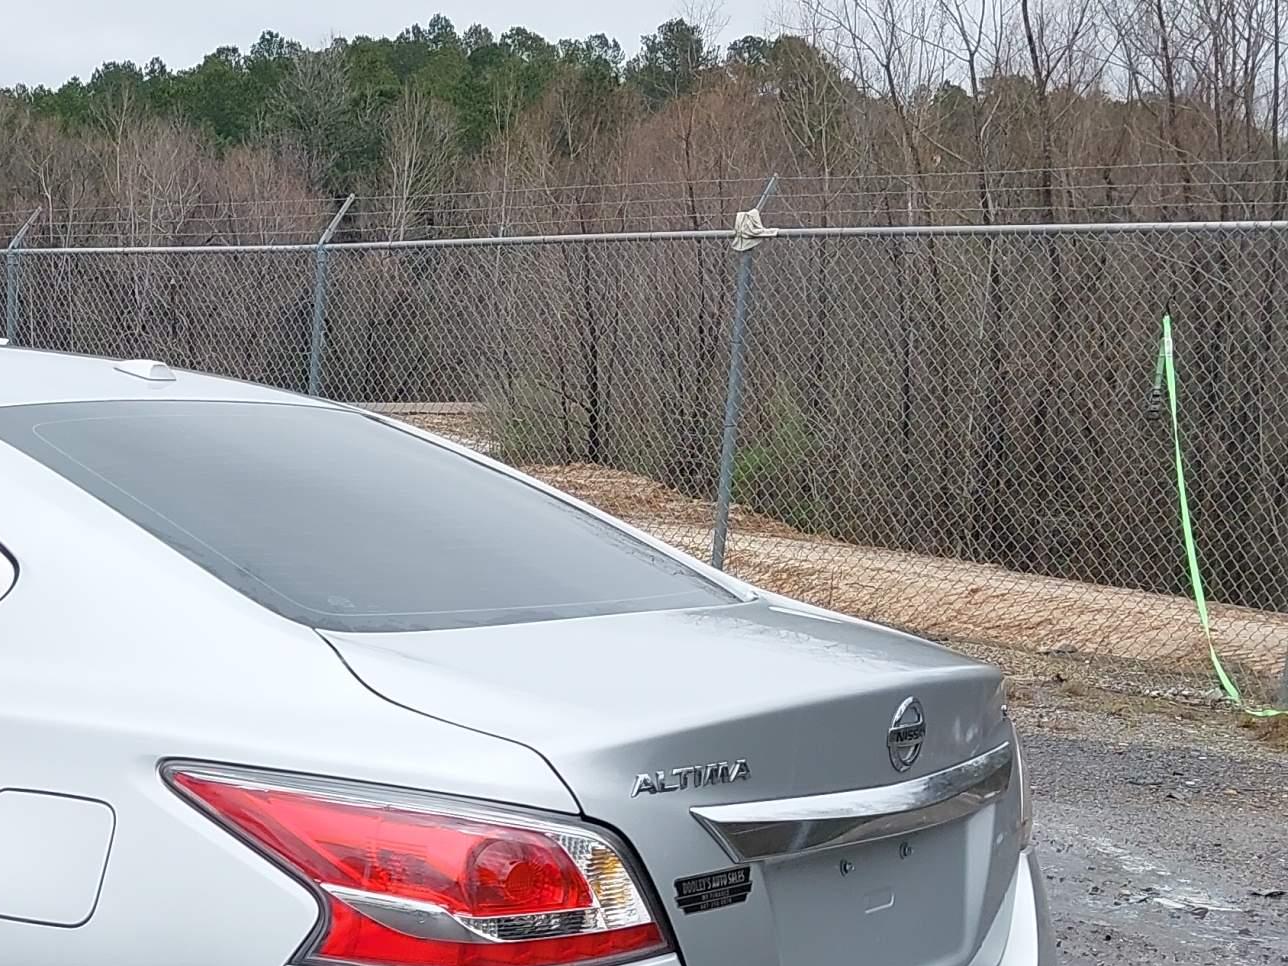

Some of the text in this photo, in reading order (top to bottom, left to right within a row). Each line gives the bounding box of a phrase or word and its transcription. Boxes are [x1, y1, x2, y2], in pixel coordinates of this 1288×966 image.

[896, 727, 926, 742] NISSA
[631, 758, 752, 798] ALTIMA
[712, 873, 728, 889] AUTO
[727, 869, 745, 885] SALES
